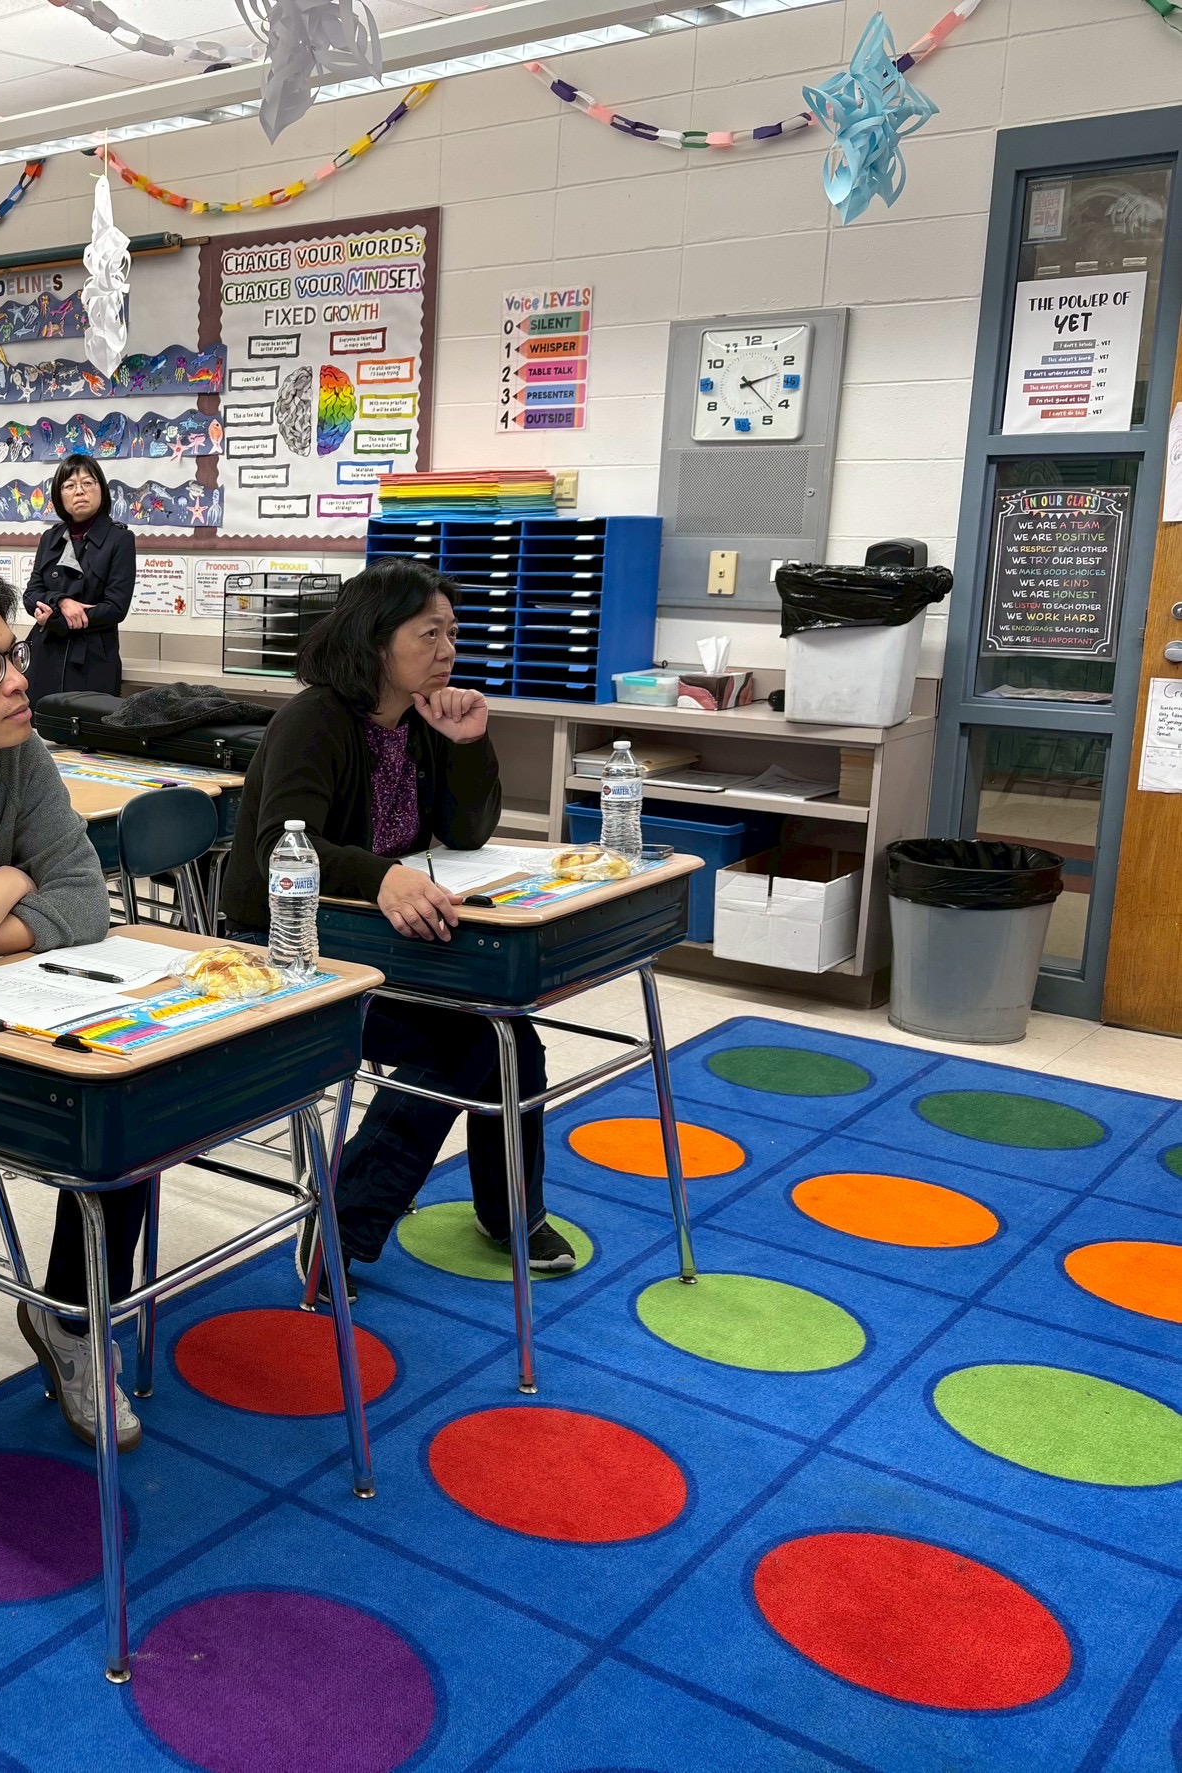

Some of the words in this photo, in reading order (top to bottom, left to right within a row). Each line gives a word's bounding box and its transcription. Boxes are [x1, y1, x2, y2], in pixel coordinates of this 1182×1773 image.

[225, 252, 290, 272] CHANGE
[298, 245, 343, 264] YOUR
[349, 237, 421, 257] WORDS;
[225, 281, 290, 302] CHANGE
[298, 277, 343, 295] YOUR
[349, 269, 420, 290] MINDSET.
[506, 296, 540, 312] Voice
[543, 288, 590, 309] LEVELS
[1029, 297, 1054, 311] THE
[1059, 292, 1108, 310] POWER
[1113, 291, 1131, 305] OF
[265, 307, 316, 326] FIXED
[323, 303, 379, 323] GROWTH
[504, 320, 513, 335] 0
[530, 317, 572, 330] SILENT
[1054, 312, 1092, 334] YET
[745, 336, 762, 346] 12
[505, 342, 511, 358] 1
[530, 342, 576, 353] WHISPER
[707, 359, 724, 369] 10
[783, 356, 795, 365] 2
[502, 367, 510, 382] 2
[528, 368, 551, 376] TABLE
[501, 388, 510, 404] 3
[527, 391, 574, 399] PRESENTER
[707, 402, 717, 411] 8
[778, 400, 789, 409] 4
[501, 411, 509, 429] 4
[526, 413, 572, 424] OUTSIDE
[721, 417, 730, 426] 7
[762, 416, 773, 425] 5
[1023, 497, 1037, 509] IN
[1041, 496, 1062, 507] OUR
[1067, 495, 1098, 507] CLASS
[1018, 522, 1033, 530] WE
[1060, 521, 1066, 529] A
[1070, 521, 1100, 529] TEAM
[1056, 533, 1105, 541] POSITIVE
[145, 559, 173, 567] Adverb
[1076, 557, 1102, 565] BEST
[206, 562, 239, 570] Pronouns
[270, 562, 308, 572] Pronouns
[1019, 579, 1035, 587] WE
[1038, 579, 1059, 587] ARE
[1012, 590, 1028, 598] WE
[1053, 591, 1096, 599] HONEST
[1027, 613, 1059, 621] WORK
[1064, 614, 1095, 622] HARD
[612, 787, 630, 795] WATER
[294, 880, 313, 889] WATER
